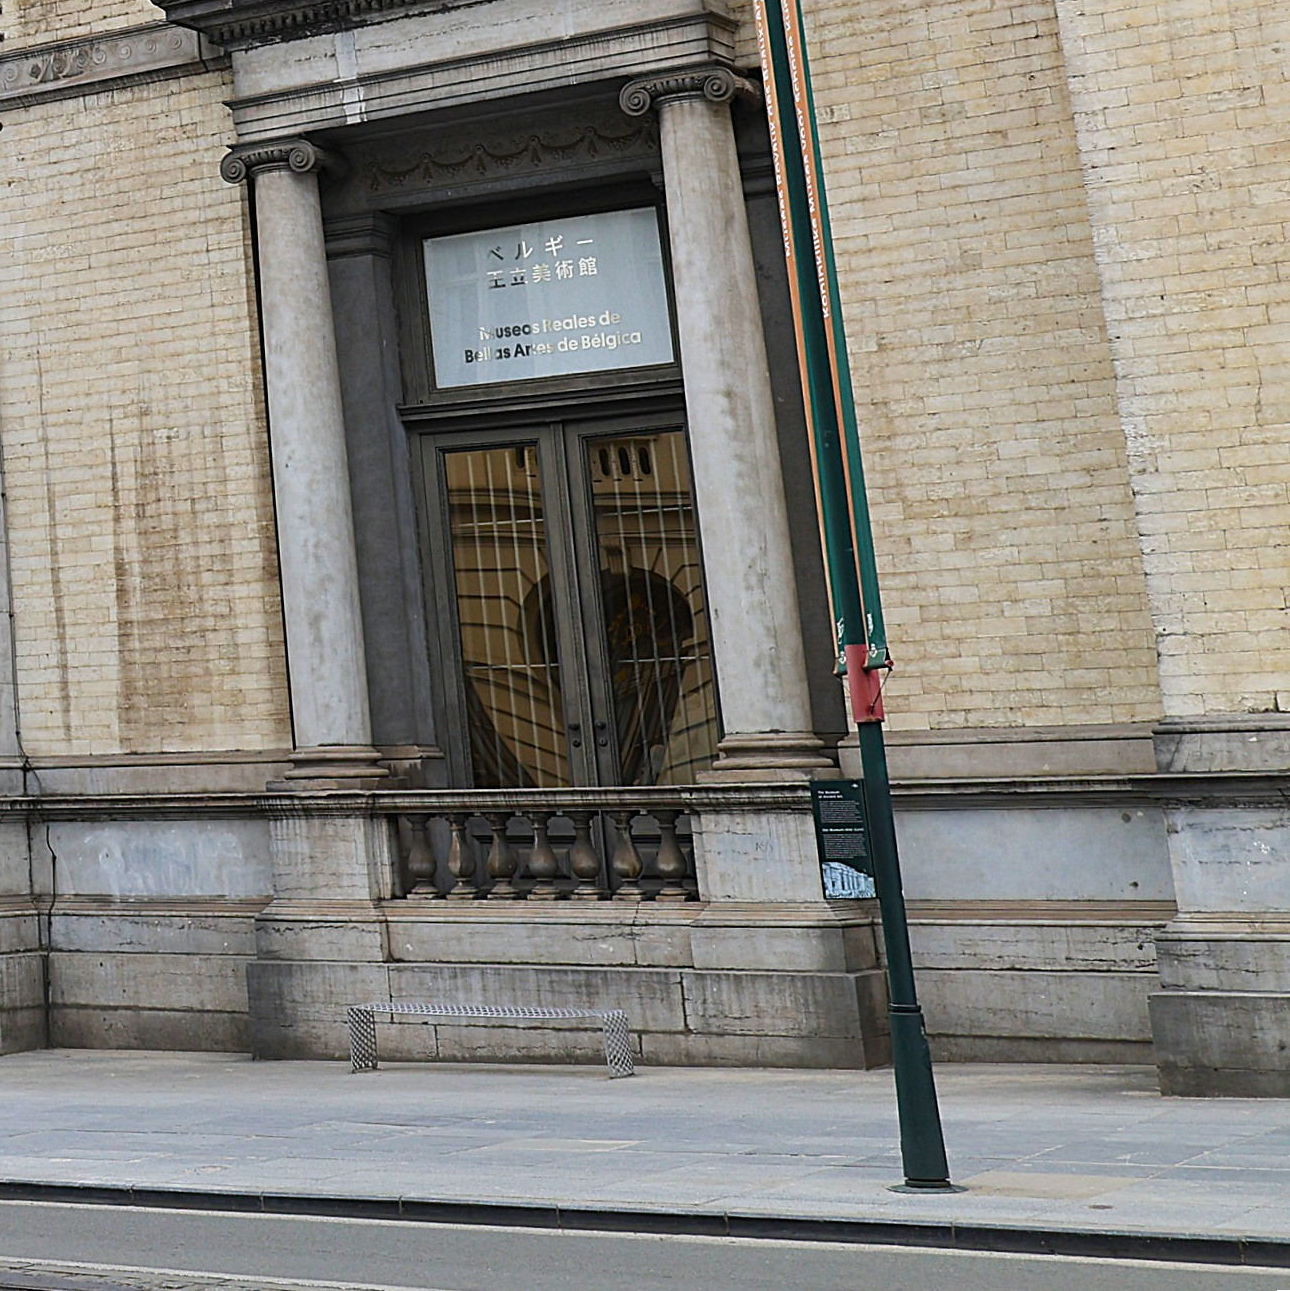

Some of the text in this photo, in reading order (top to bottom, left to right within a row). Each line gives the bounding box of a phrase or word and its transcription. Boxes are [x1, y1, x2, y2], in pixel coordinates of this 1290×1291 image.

[787, 37, 801, 103] Schone
[764, 85, 775, 117] des
[796, 108, 808, 150] voor
[769, 122, 785, 186] Royaux
[803, 154, 816, 213] Musea
[488, 234, 594, 261] ベルギー
[486, 257, 598, 290] 王立美術館
[479, 310, 621, 341] Museos Reales de
[464, 331, 643, 363] Bellas Artes de Bélgica
